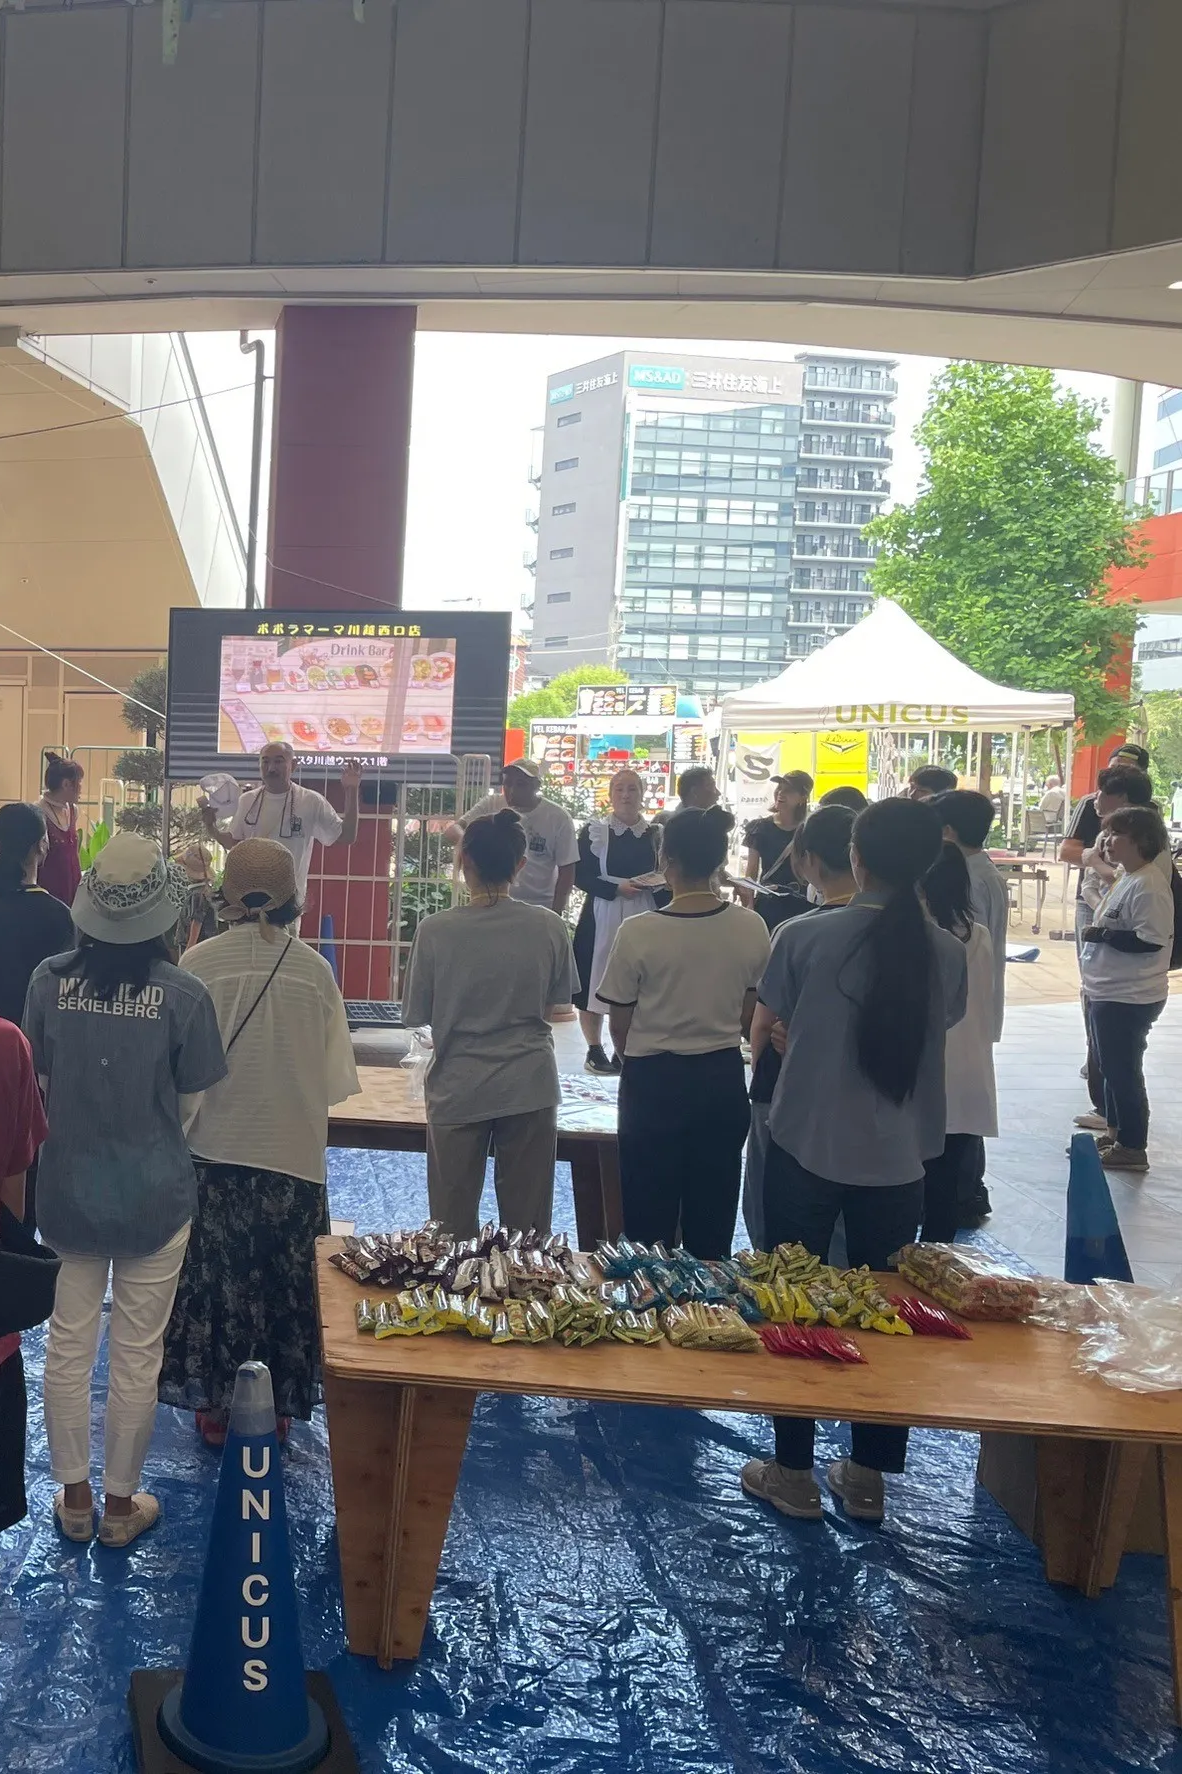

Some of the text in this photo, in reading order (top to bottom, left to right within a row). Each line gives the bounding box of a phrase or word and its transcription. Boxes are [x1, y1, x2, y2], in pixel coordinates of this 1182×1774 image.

[633, 369, 682, 385] MS&AD
[692, 372, 782, 395] 三井住友海上
[330, 643, 387, 657] Drink Bar
[835, 703, 969, 725] UNICUS
[58, 977, 89, 997] MY
[57, 996, 162, 1020] SEKIELBERG.
[241, 1446, 270, 1692] UNICUS
